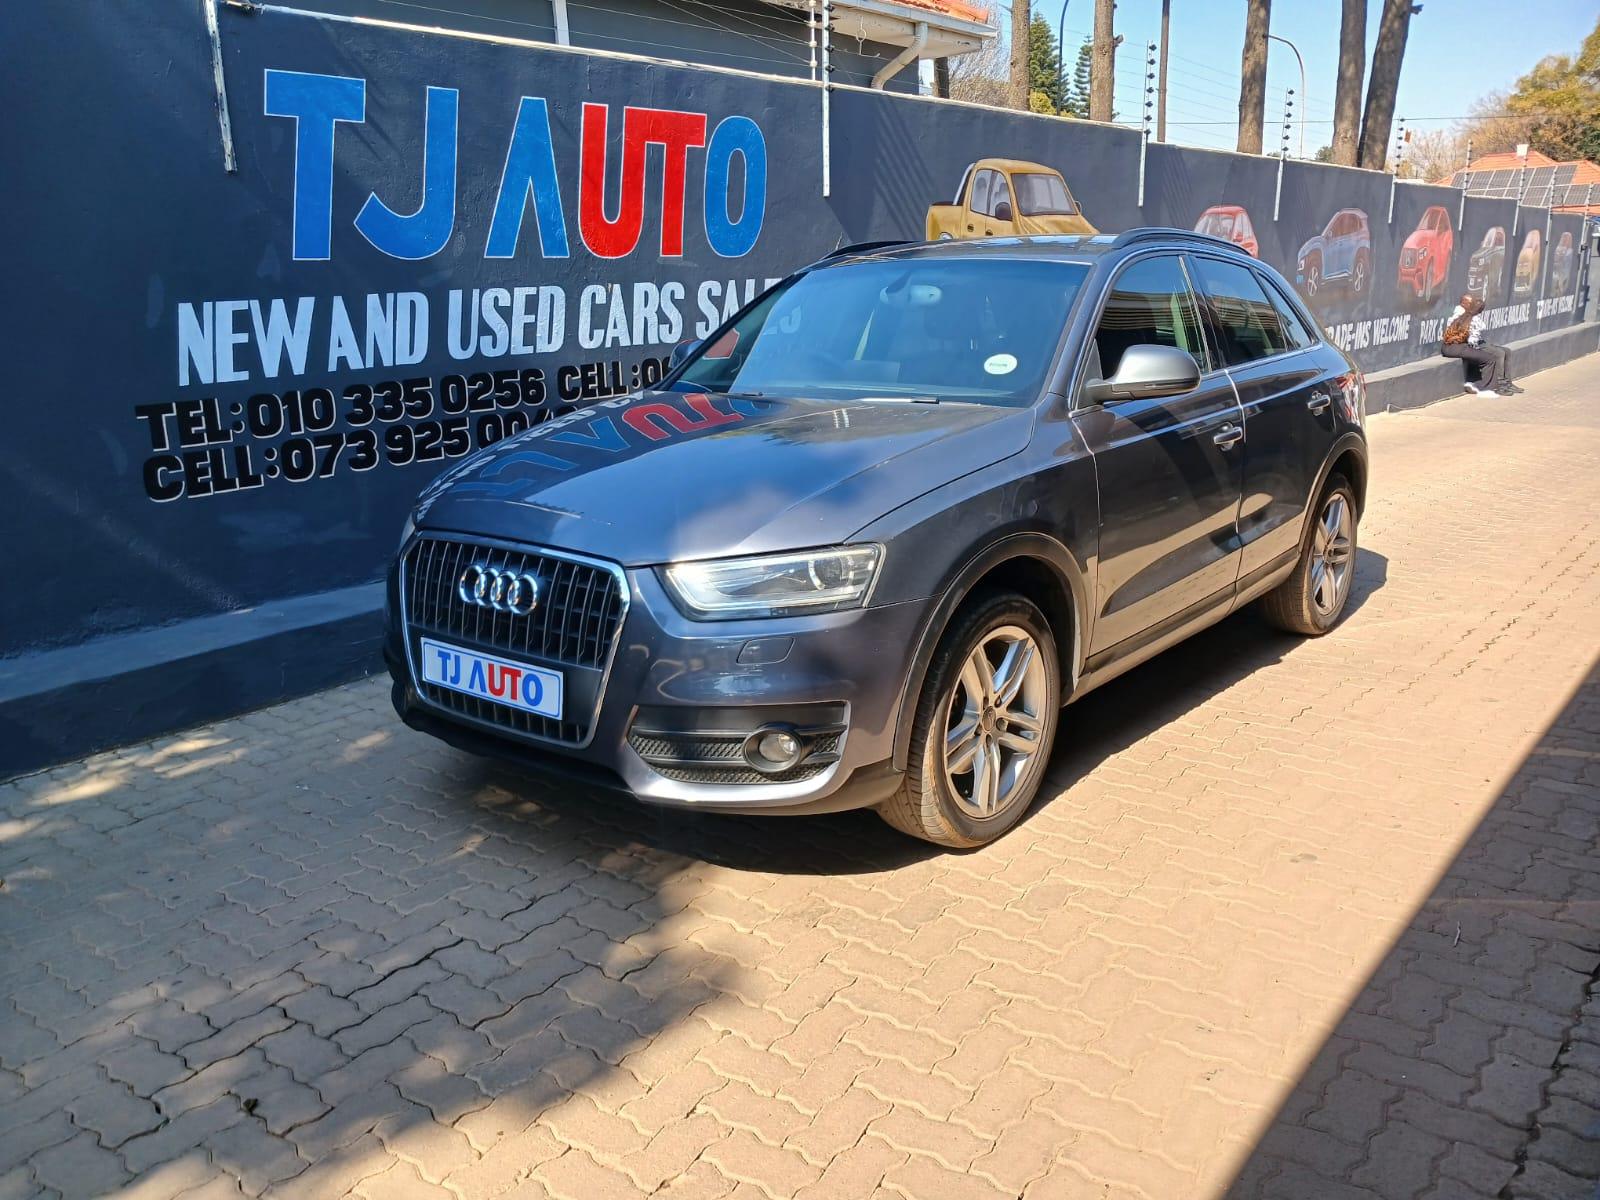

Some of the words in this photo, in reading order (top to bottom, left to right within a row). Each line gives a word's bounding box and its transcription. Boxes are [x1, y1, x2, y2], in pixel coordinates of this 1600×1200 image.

[264, 68, 459, 261] TJ
[484, 96, 767, 259] AUTO
[177, 296, 315, 386] NEW
[328, 290, 429, 372] AND
[447, 284, 566, 361] USED
[578, 281, 685, 350] CARS
[1373, 314, 1411, 346] WELCOME
[1419, 320, 1439, 345] PARK
[343, 377, 434, 426] 335
[440, 368, 547, 416] 0256
[385, 416, 473, 466] 925
[476, 405, 579, 450] 00
[437, 650, 461, 685] TJ
[468, 660, 544, 707] AUTO
